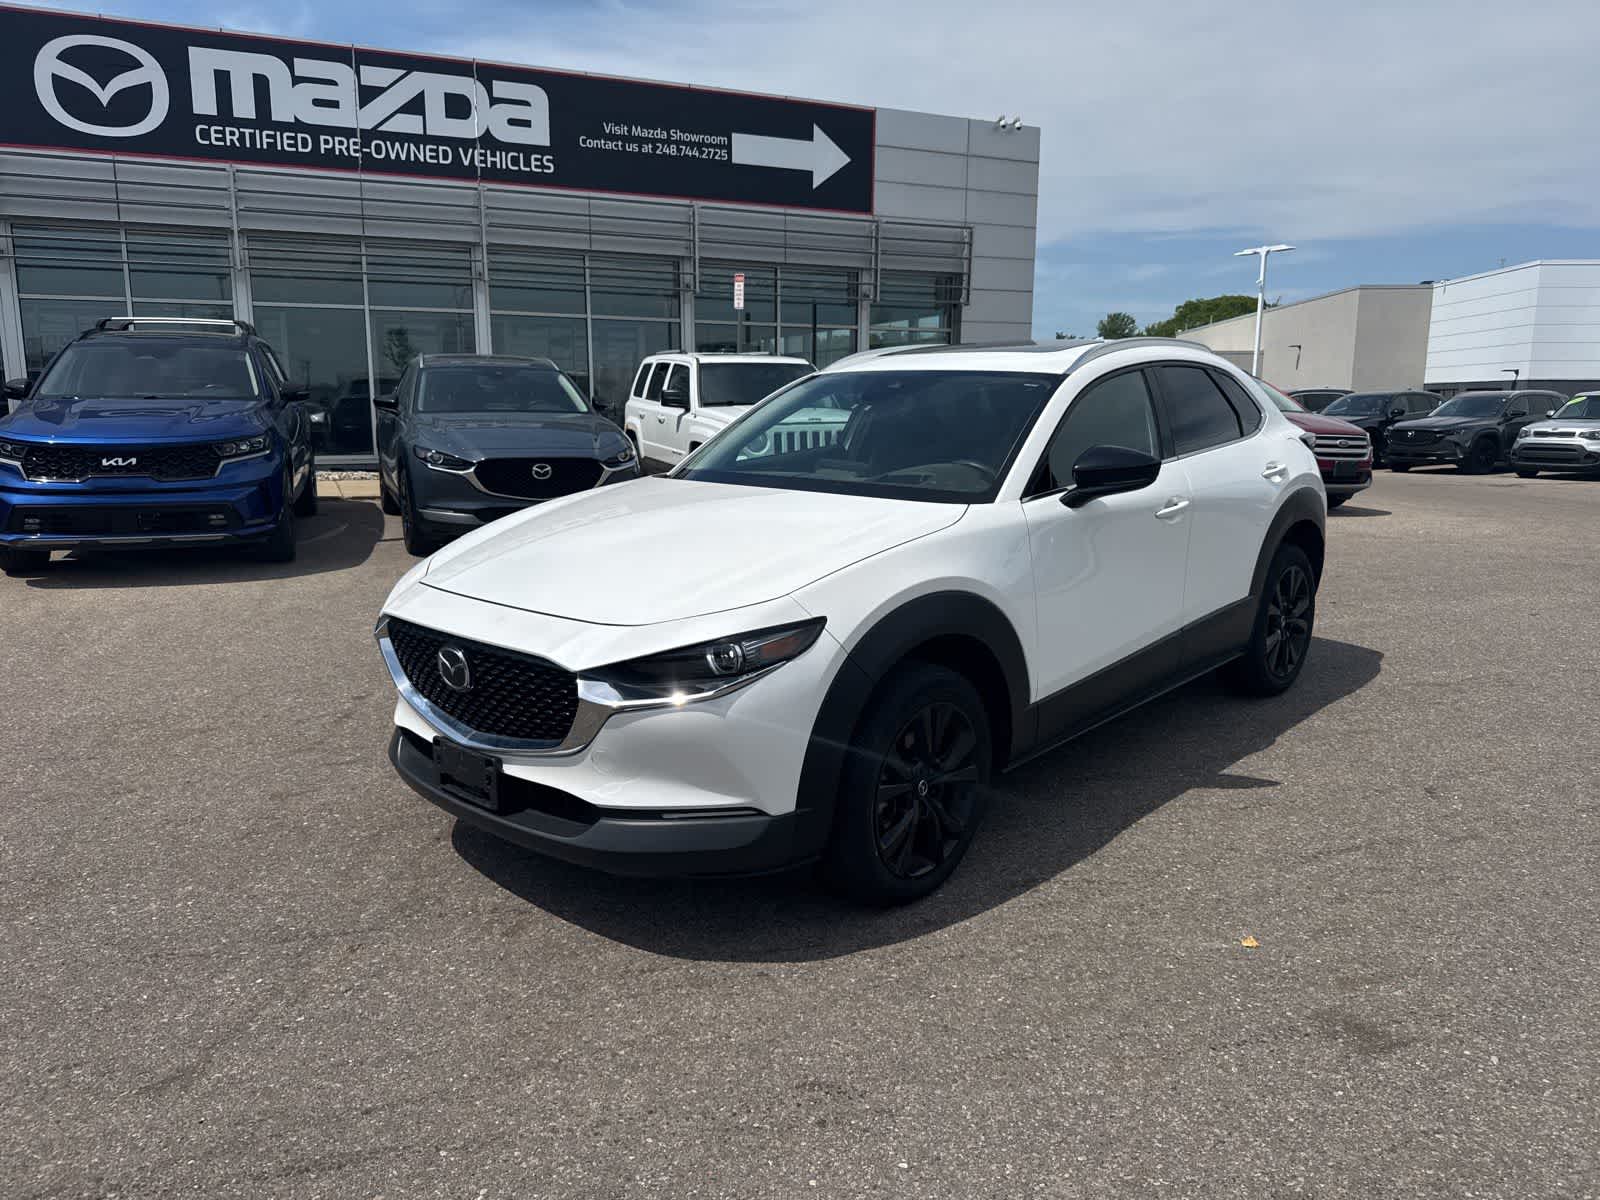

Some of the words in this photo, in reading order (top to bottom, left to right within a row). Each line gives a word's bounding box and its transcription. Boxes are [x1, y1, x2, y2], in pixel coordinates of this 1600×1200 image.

[187, 45, 551, 146] mazda
[195, 124, 313, 153] CERTIFIED
[319, 134, 453, 164] PRE-OWNED
[459, 147, 555, 173] VEHICLES
[579, 136, 622, 150] Contact
[625, 142, 639, 152] us
[641, 142, 653, 153] at
[655, 143, 728, 161] 248.744.2725
[603, 121, 629, 135] Visit
[631, 125, 667, 139] Mazda
[670, 129, 728, 145] Showroom
